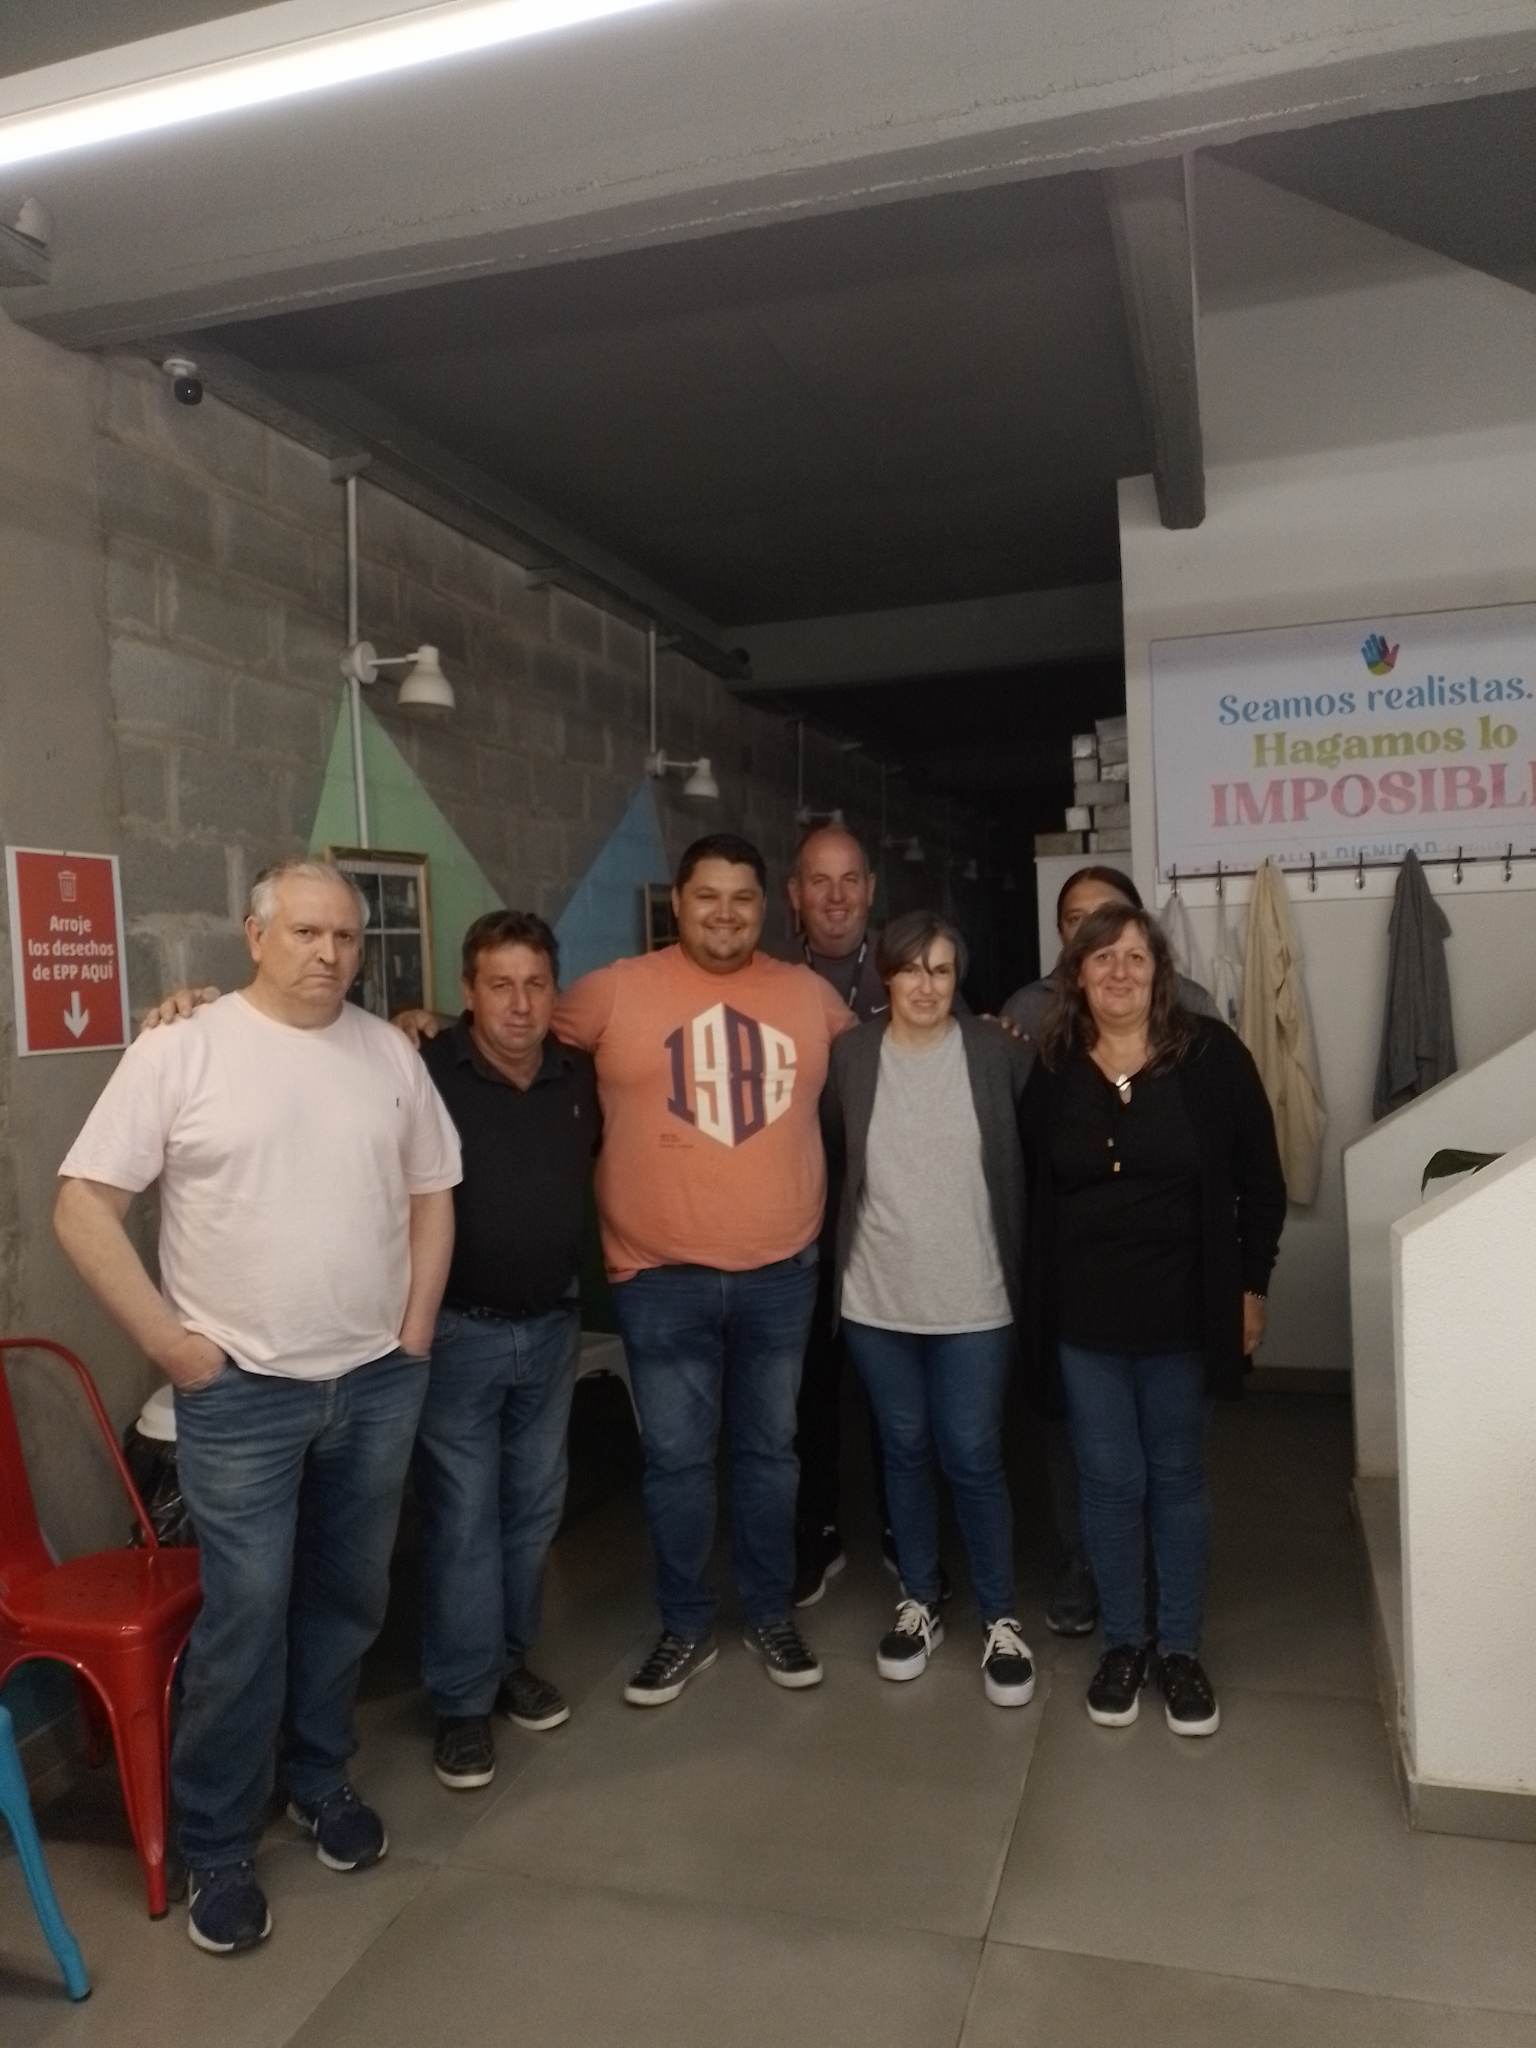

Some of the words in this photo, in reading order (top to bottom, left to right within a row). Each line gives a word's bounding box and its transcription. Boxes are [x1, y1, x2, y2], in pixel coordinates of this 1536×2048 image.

[1219, 688, 1356, 725] Seamos
[1368, 675, 1533, 712] realistas.
[1253, 726, 1467, 769] Hagamos
[1478, 715, 1518, 752] lo
[1211, 760, 1536, 827] IMPOSIBL
[28, 939, 49, 956] los
[52, 940, 114, 956] desechos
[50, 915, 92, 935] Arroje
[32, 963, 50, 981] de
[53, 965, 78, 981] EPP
[81, 960, 113, 983] AQUÍ
[664, 1002, 797, 1148] 1986
